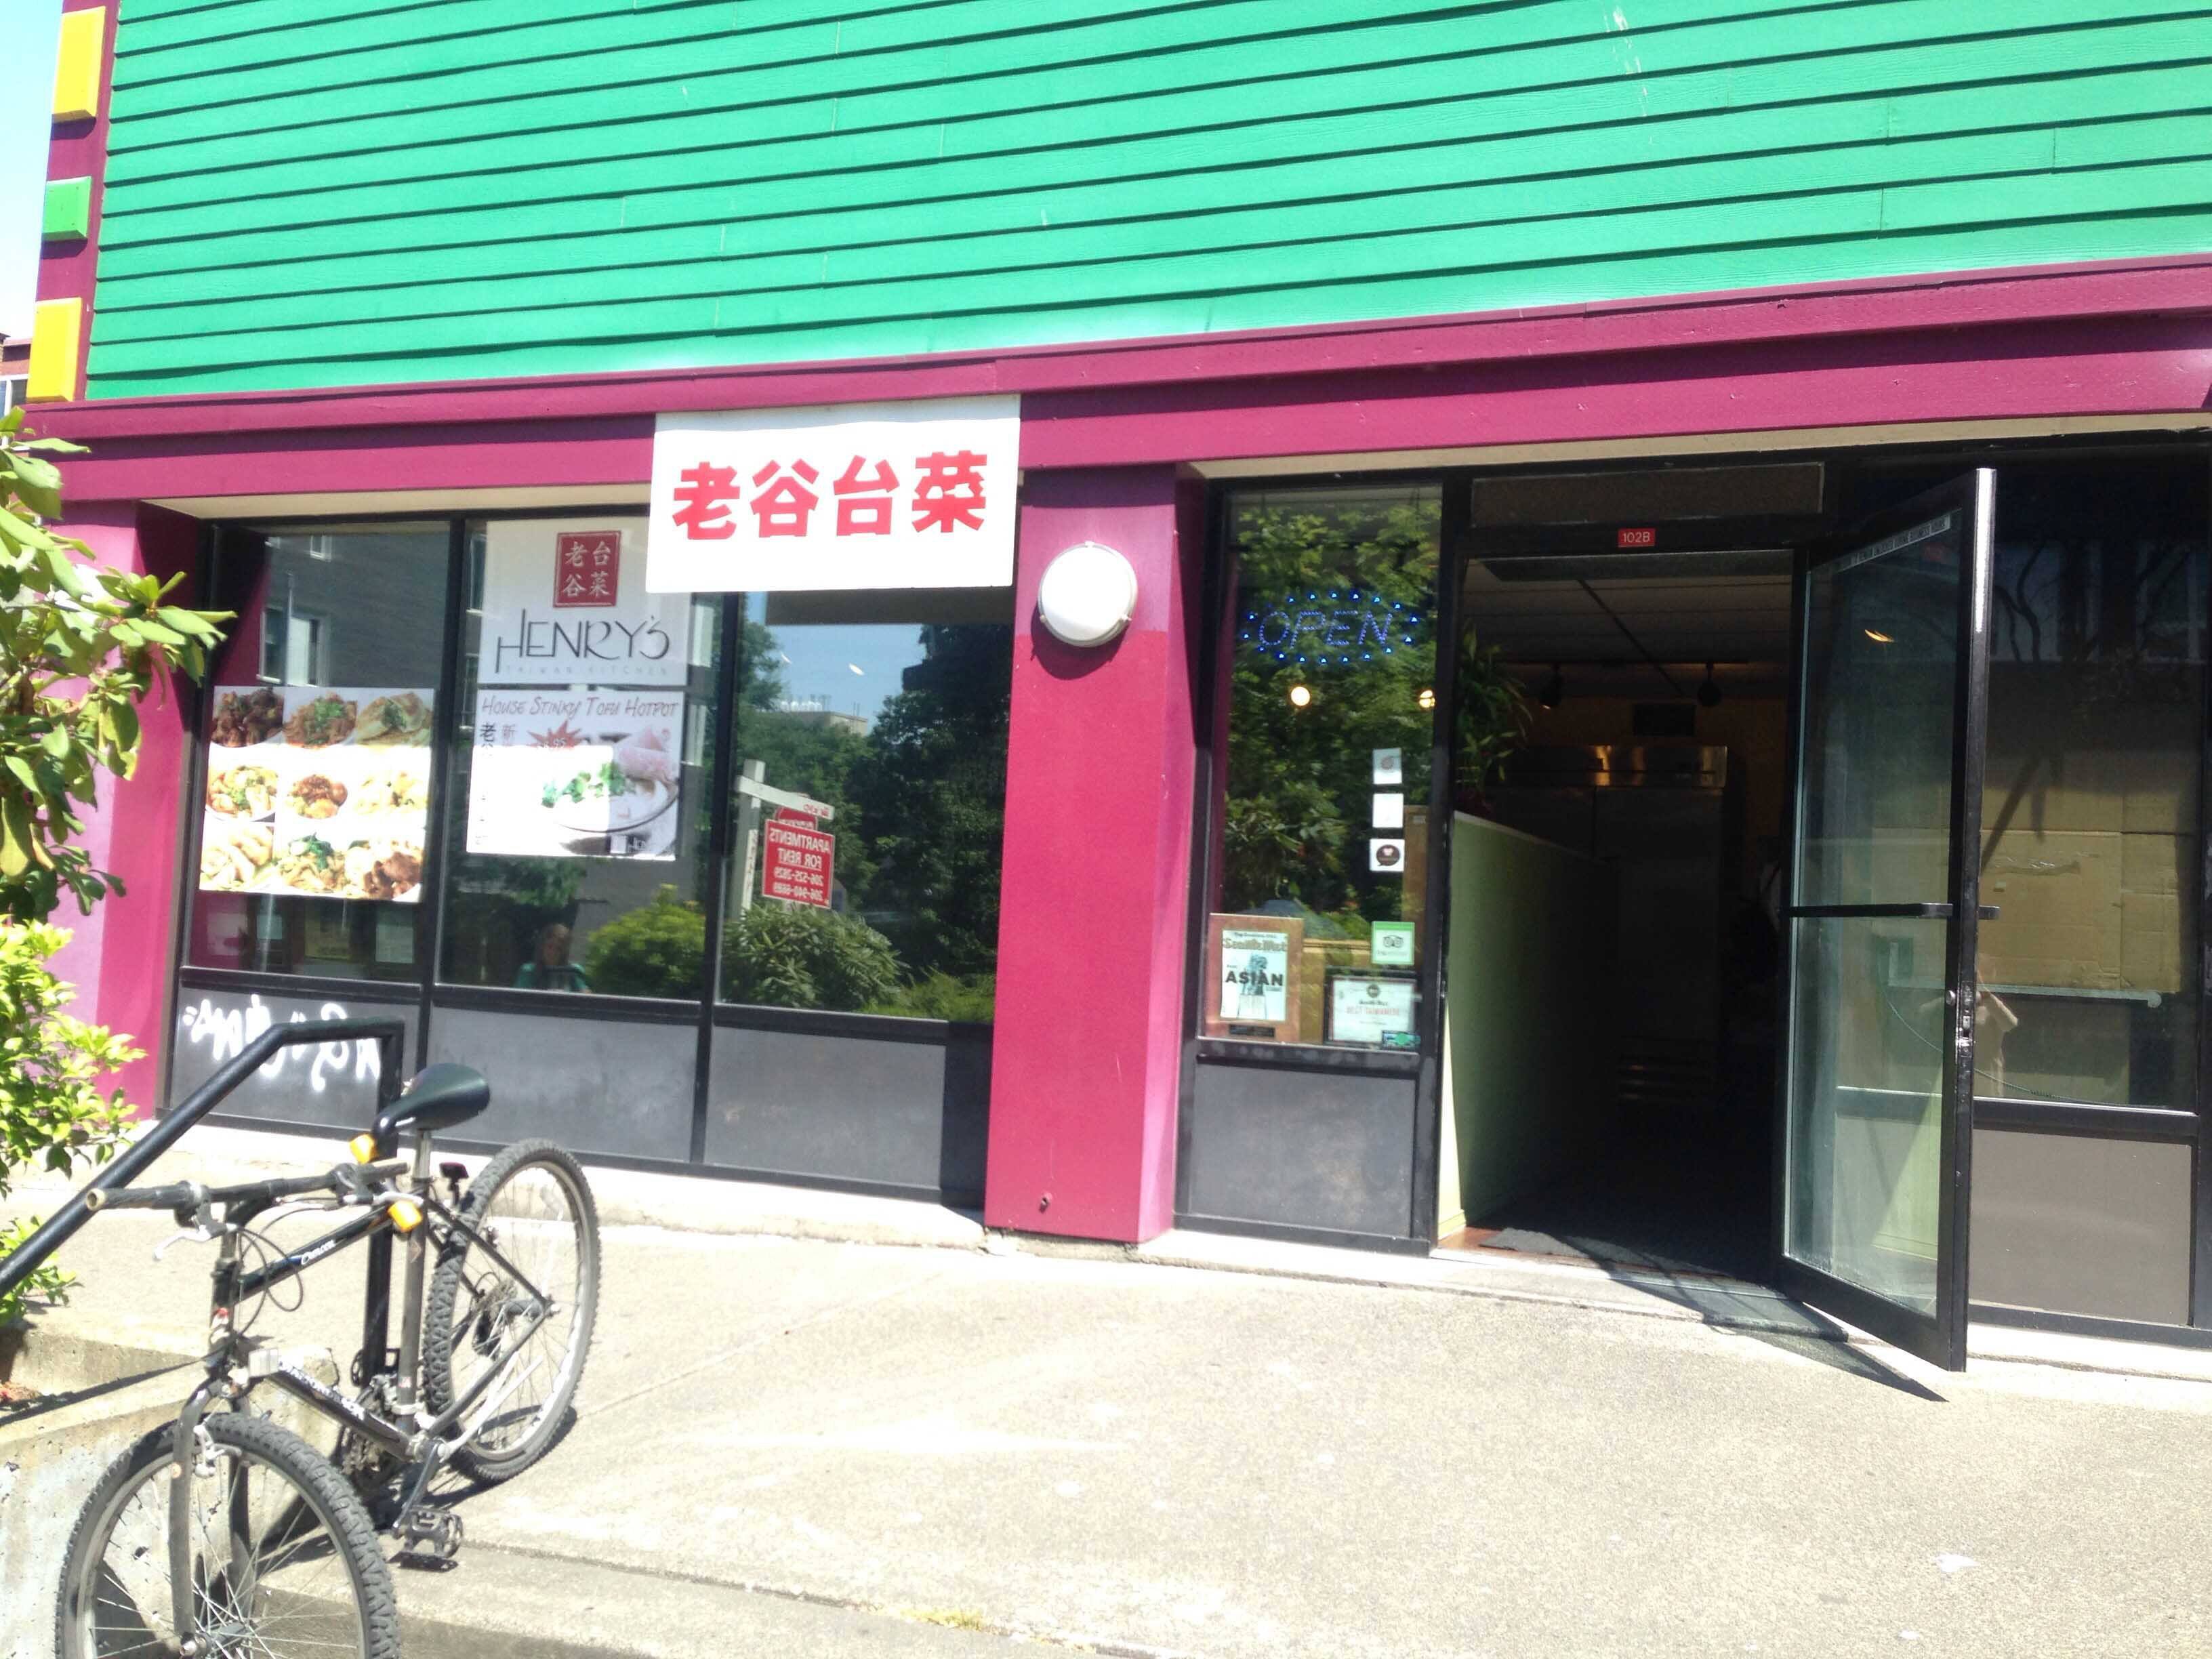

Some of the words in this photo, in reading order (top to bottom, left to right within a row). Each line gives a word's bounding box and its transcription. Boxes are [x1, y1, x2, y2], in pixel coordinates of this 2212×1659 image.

[672, 450, 988, 540] 老谷台菜
[1622, 531, 1650, 543] 102B
[1258, 611, 1393, 649] OPEN
[624, 696, 679, 718] HOTPOT
[1225, 970, 1284, 987] ASIAN
